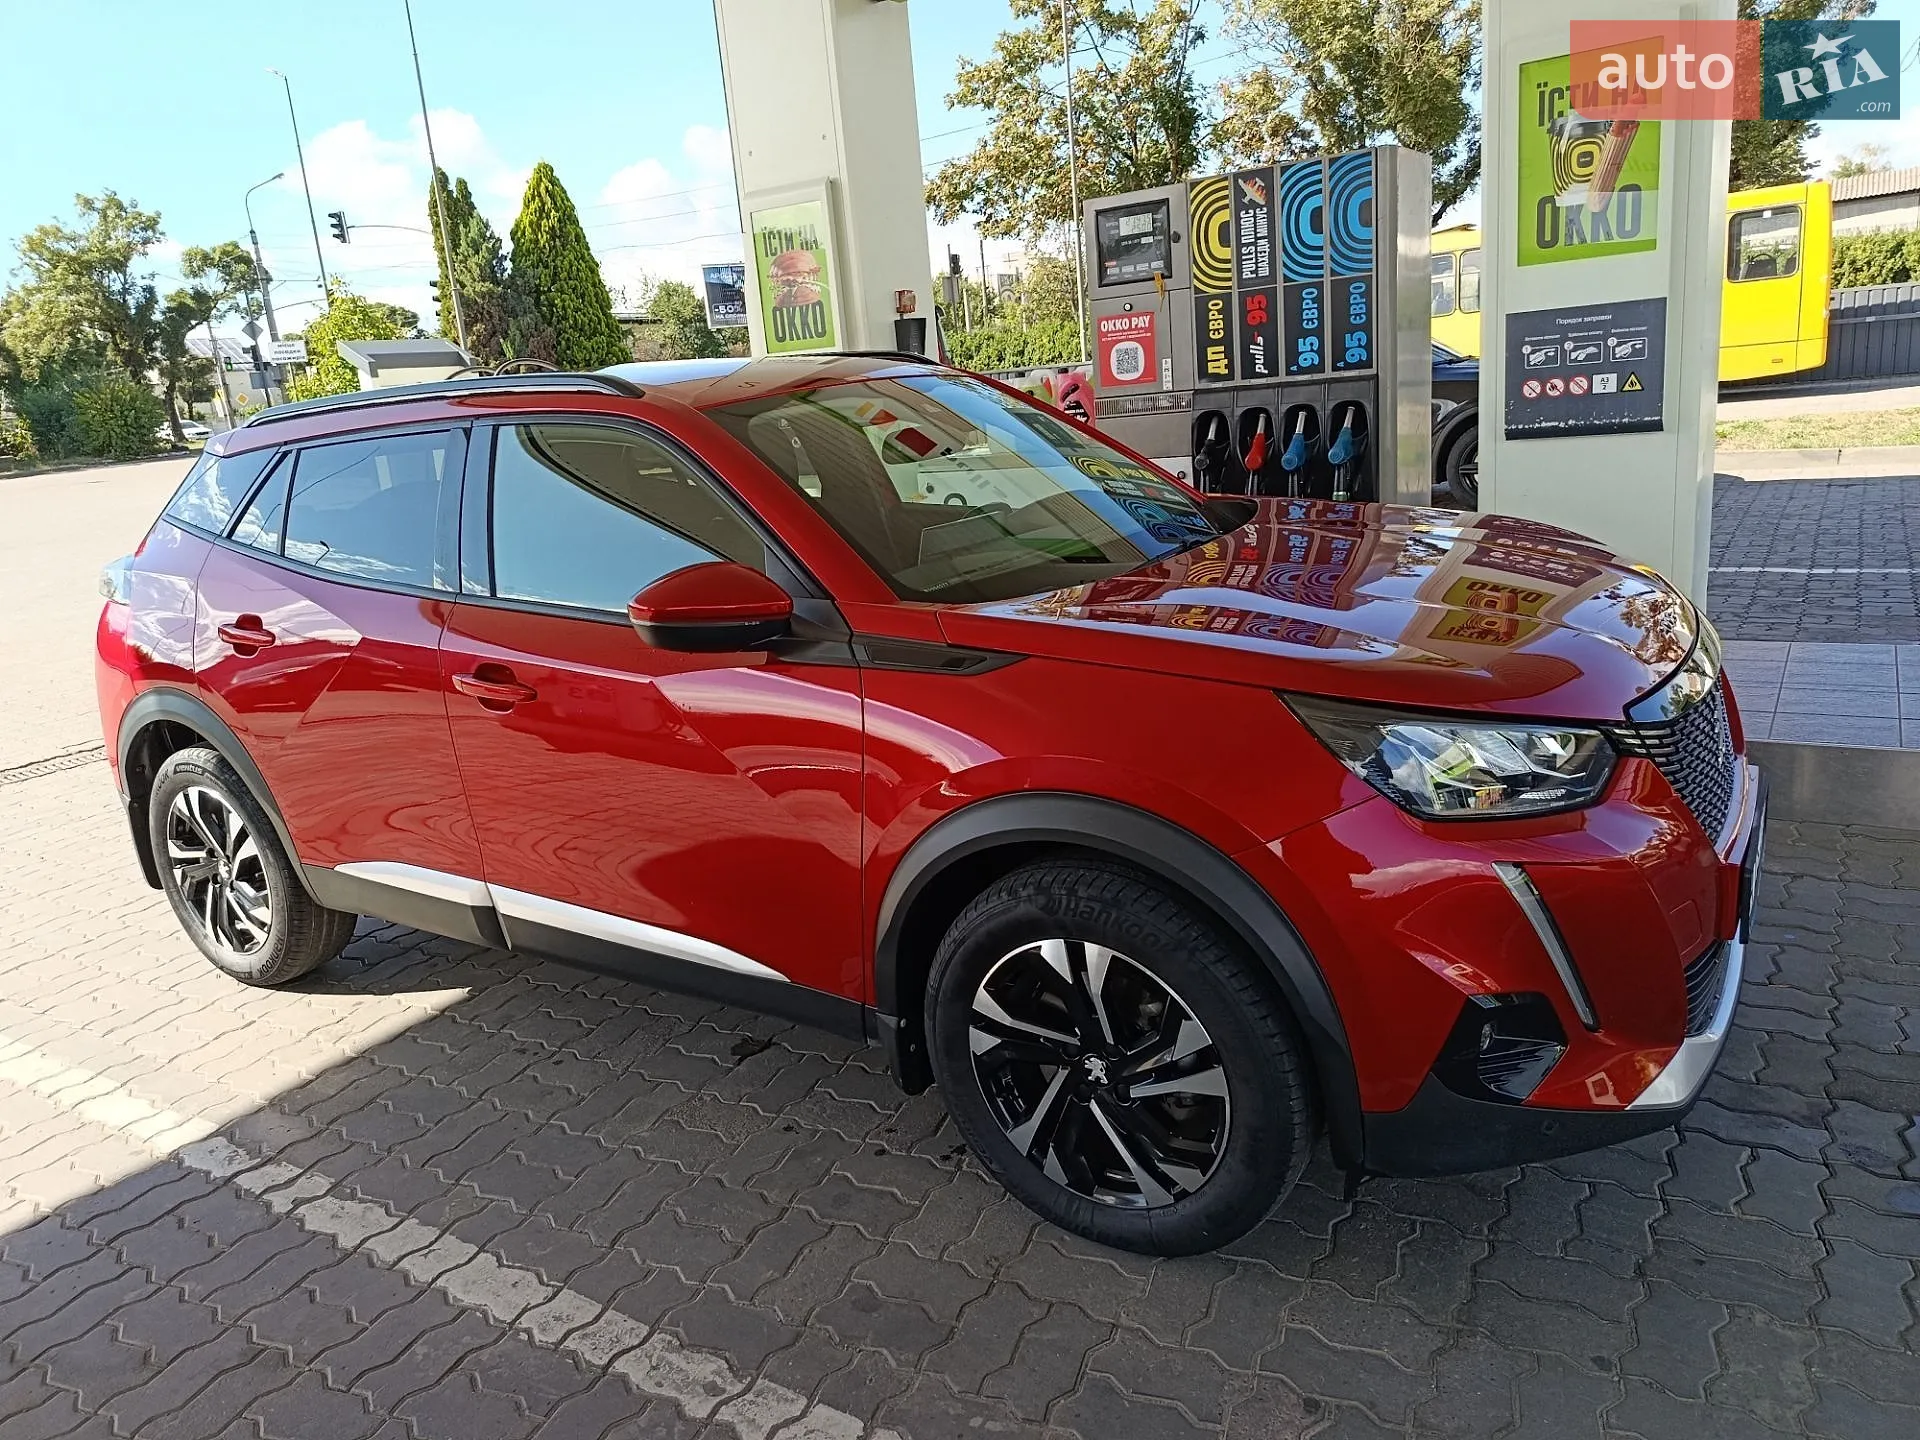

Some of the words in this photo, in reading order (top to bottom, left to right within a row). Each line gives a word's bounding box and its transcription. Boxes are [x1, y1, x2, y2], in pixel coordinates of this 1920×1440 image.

[1240, 209, 1255, 243] ПЛЮС
[1255, 207, 1268, 237] МІНУС
[1241, 246, 1256, 279] PULLS
[1257, 239, 1270, 277] ШАХЕДИ
[1208, 299, 1225, 339] ЄВРО
[1246, 294, 1267, 325] 95
[1302, 287, 1319, 329] ЄВРО
[1349, 281, 1367, 324] ЄВРО
[772, 300, 827, 343] ОККО
[1100, 318, 1130, 332] OKKO
[1131, 315, 1151, 329] PAY
[1555, 317, 1582, 326] Порядок
[1207, 345, 1229, 374] ДП
[1249, 335, 1269, 374] pulls
[1298, 336, 1319, 367] 95
[1345, 331, 1367, 363] 95
